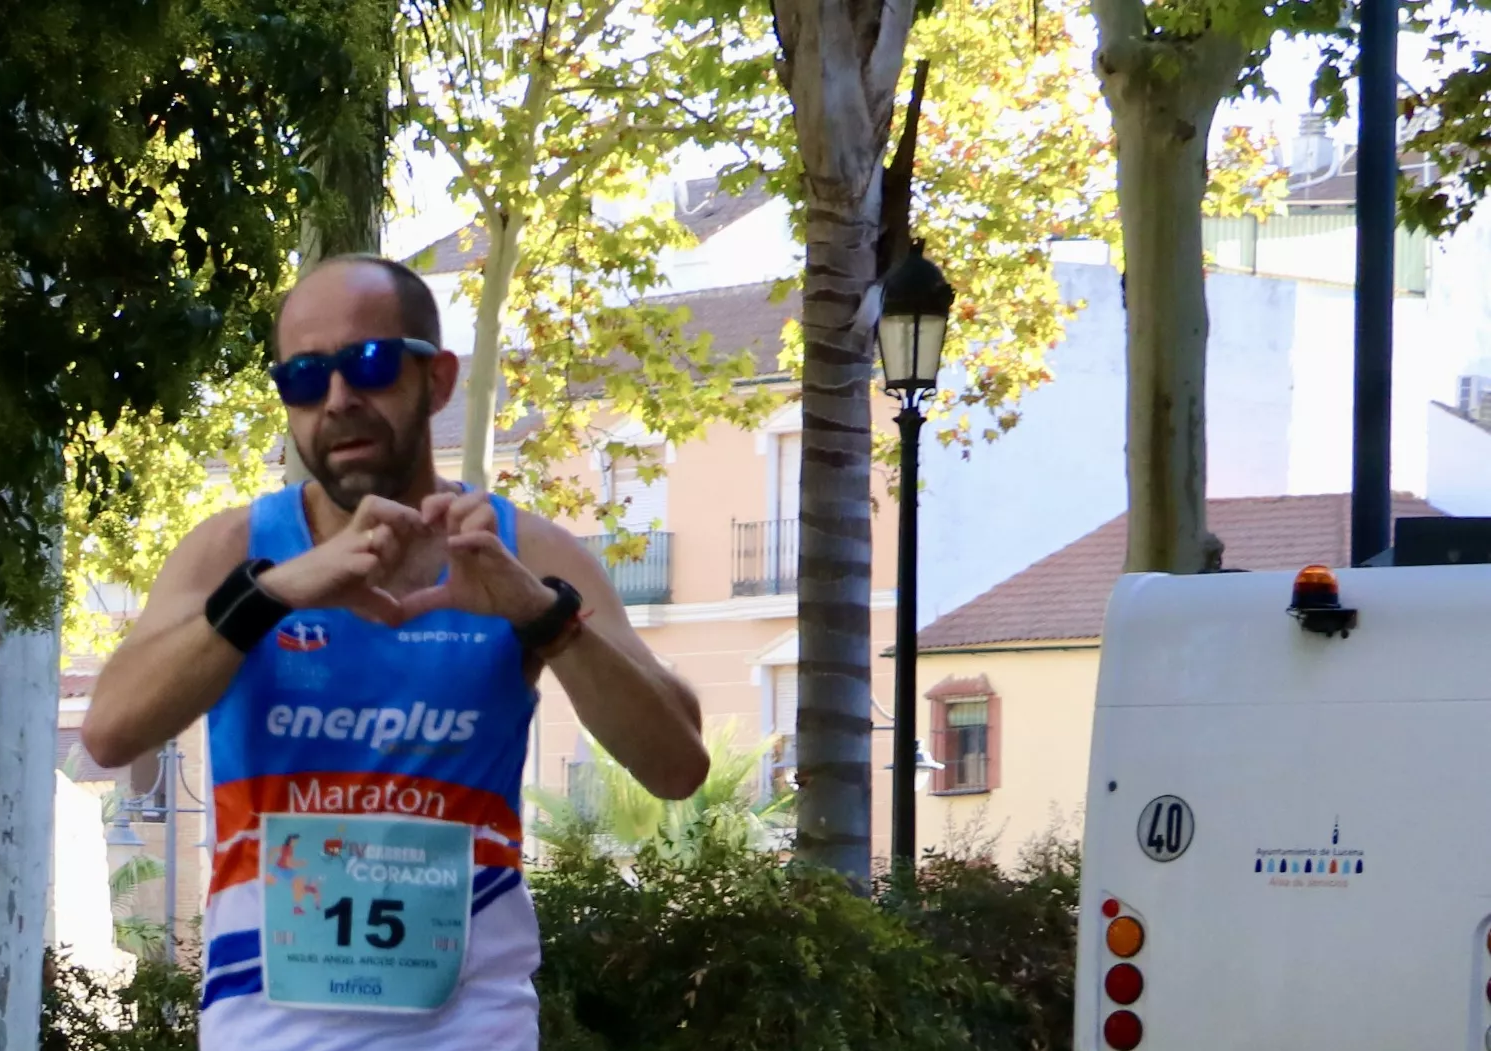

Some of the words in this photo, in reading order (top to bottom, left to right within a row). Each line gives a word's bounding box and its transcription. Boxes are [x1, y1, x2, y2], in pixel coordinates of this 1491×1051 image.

[267, 701, 480, 750] enerplus
[288, 778, 446, 818] Maratón
[1147, 802, 1183, 853] 40
[324, 897, 406, 949] 15
